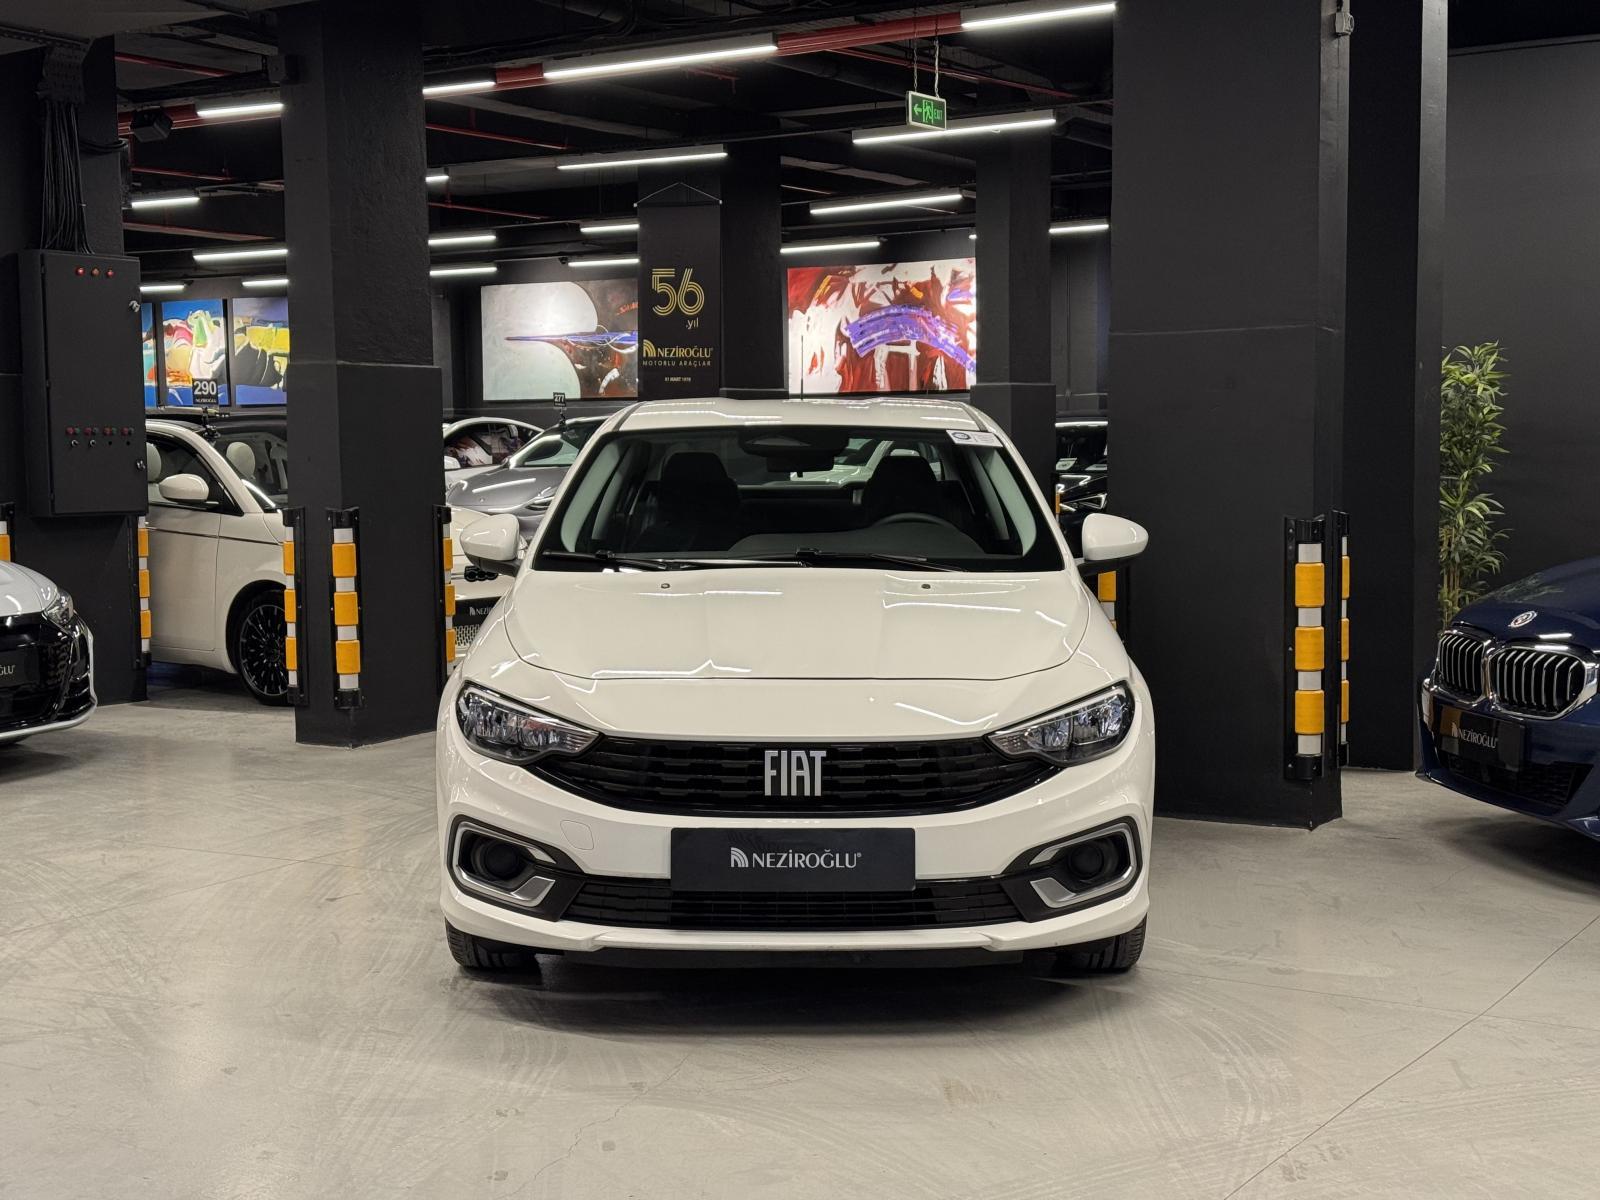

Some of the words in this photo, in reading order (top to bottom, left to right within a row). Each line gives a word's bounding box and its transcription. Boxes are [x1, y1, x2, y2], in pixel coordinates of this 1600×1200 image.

[652, 268, 705, 316] 56
[657, 345, 711, 358] NEZİROĞLU
[193, 380, 217, 395] 290
[764, 750, 827, 797] FIAT
[752, 849, 858, 869] NEZİROĞLU
